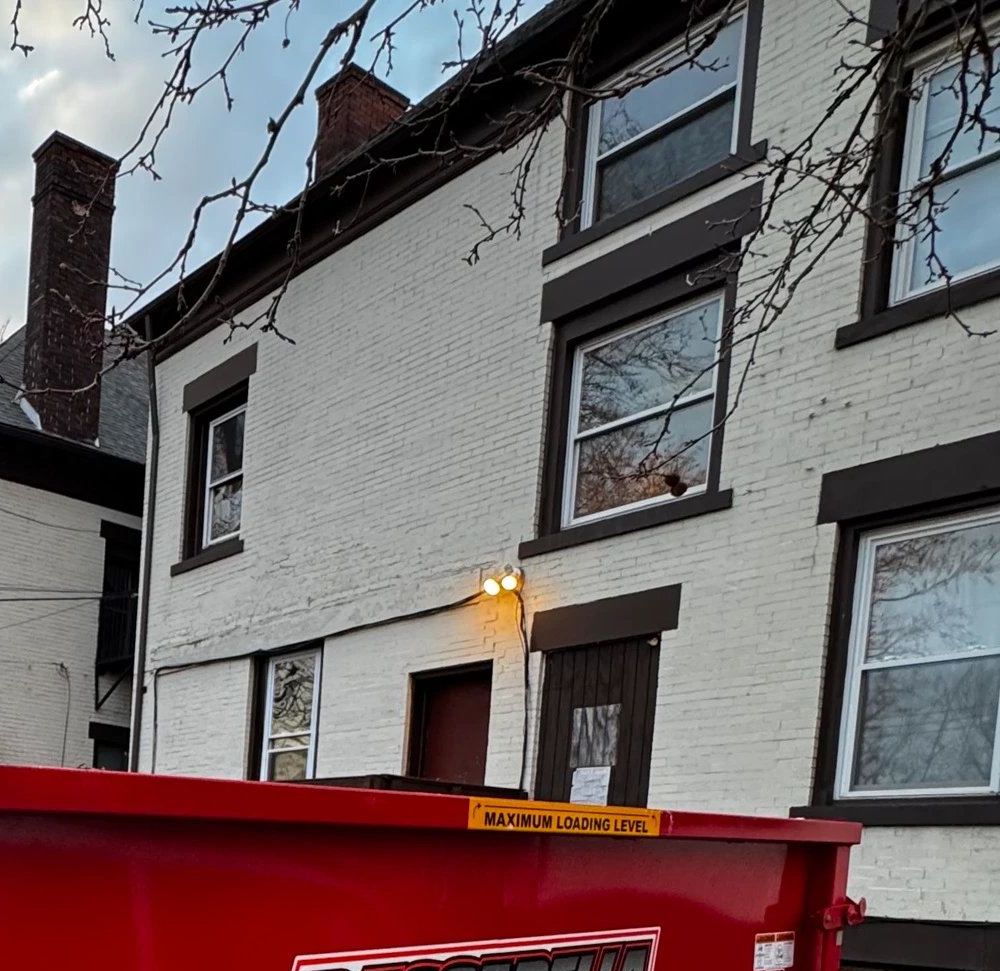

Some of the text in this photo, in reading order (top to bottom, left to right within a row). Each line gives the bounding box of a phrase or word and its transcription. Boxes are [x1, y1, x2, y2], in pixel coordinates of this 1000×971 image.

[484, 812, 648, 833] MAXIMUM LOADING LEVEL
